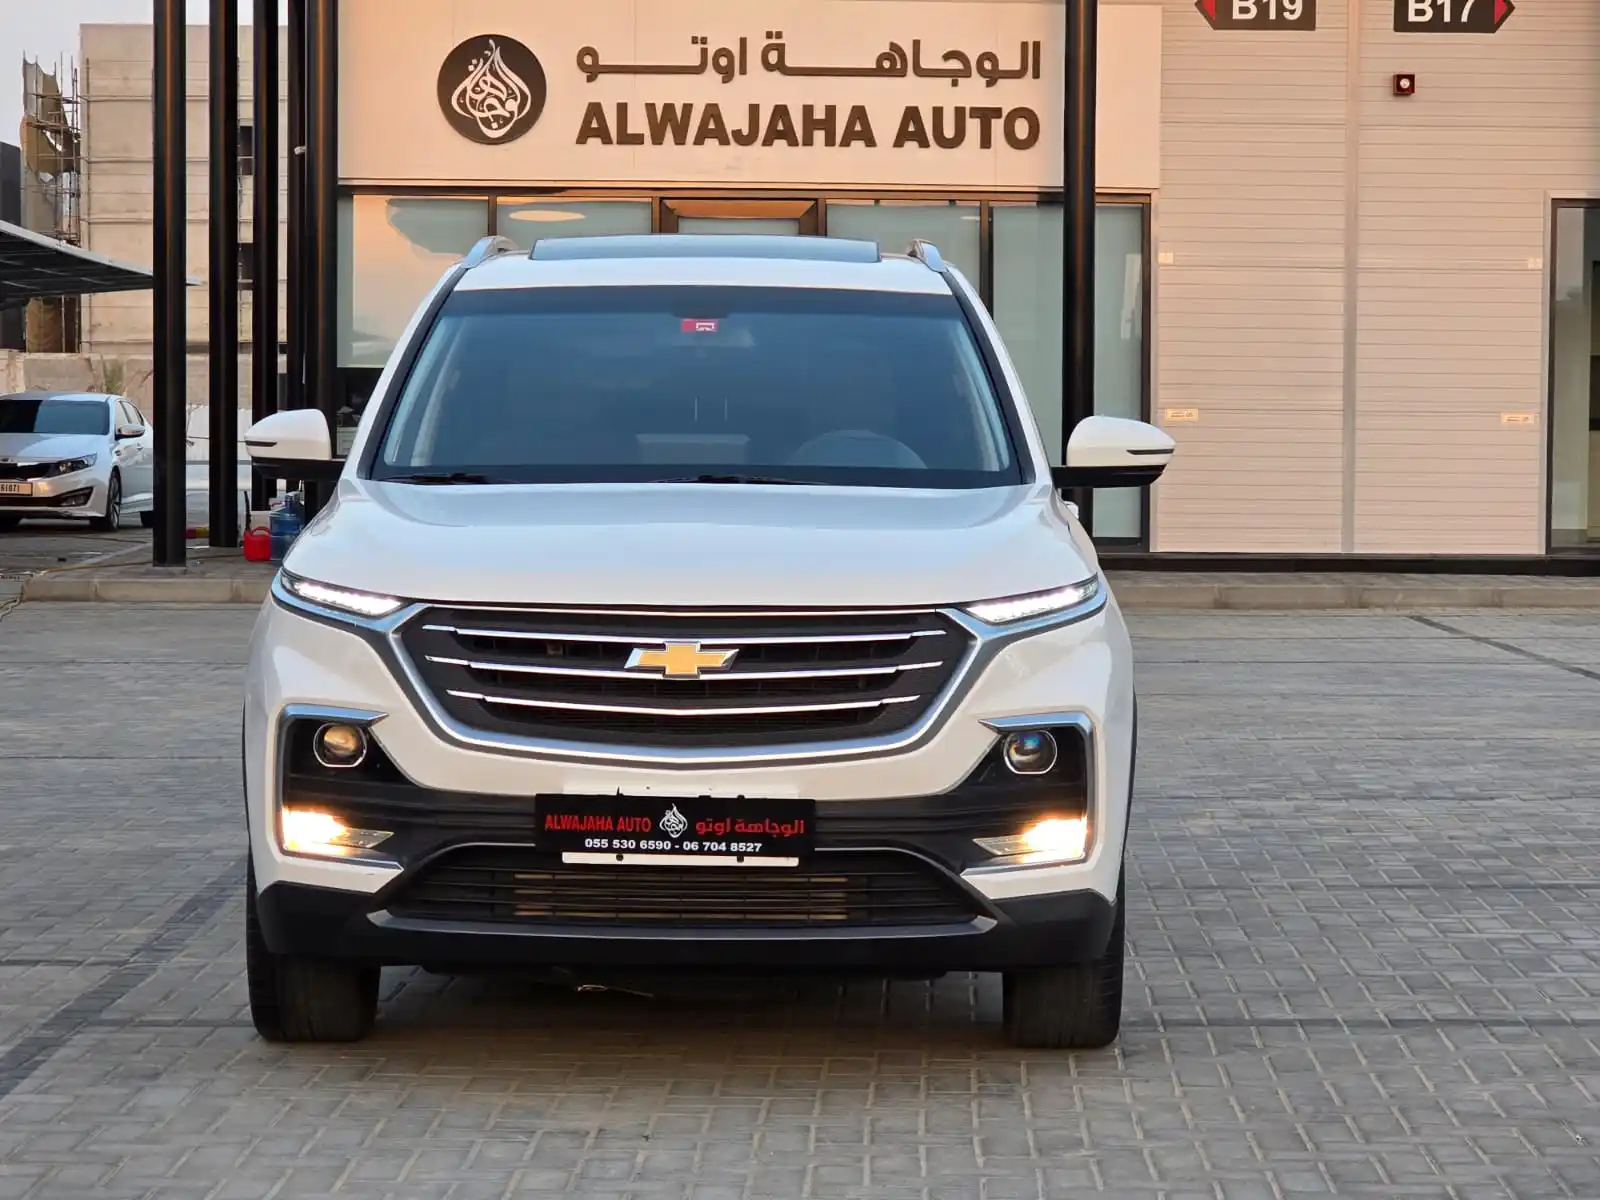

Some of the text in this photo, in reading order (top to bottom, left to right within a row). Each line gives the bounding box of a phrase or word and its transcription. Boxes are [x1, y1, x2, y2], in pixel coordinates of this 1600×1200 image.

[1232, 0, 1303, 20] B19
[1407, 0, 1476, 23] B17
[575, 102, 1041, 150] ALWAJAHA AUTO
[545, 814, 652, 833] ALWAJAHA AUTO
[585, 838, 609, 849] 055
[612, 839, 636, 850] 530
[639, 840, 671, 851] 6590
[683, 841, 699, 851] 06
[703, 841, 727, 852] 704
[730, 842, 762, 853] 8527
